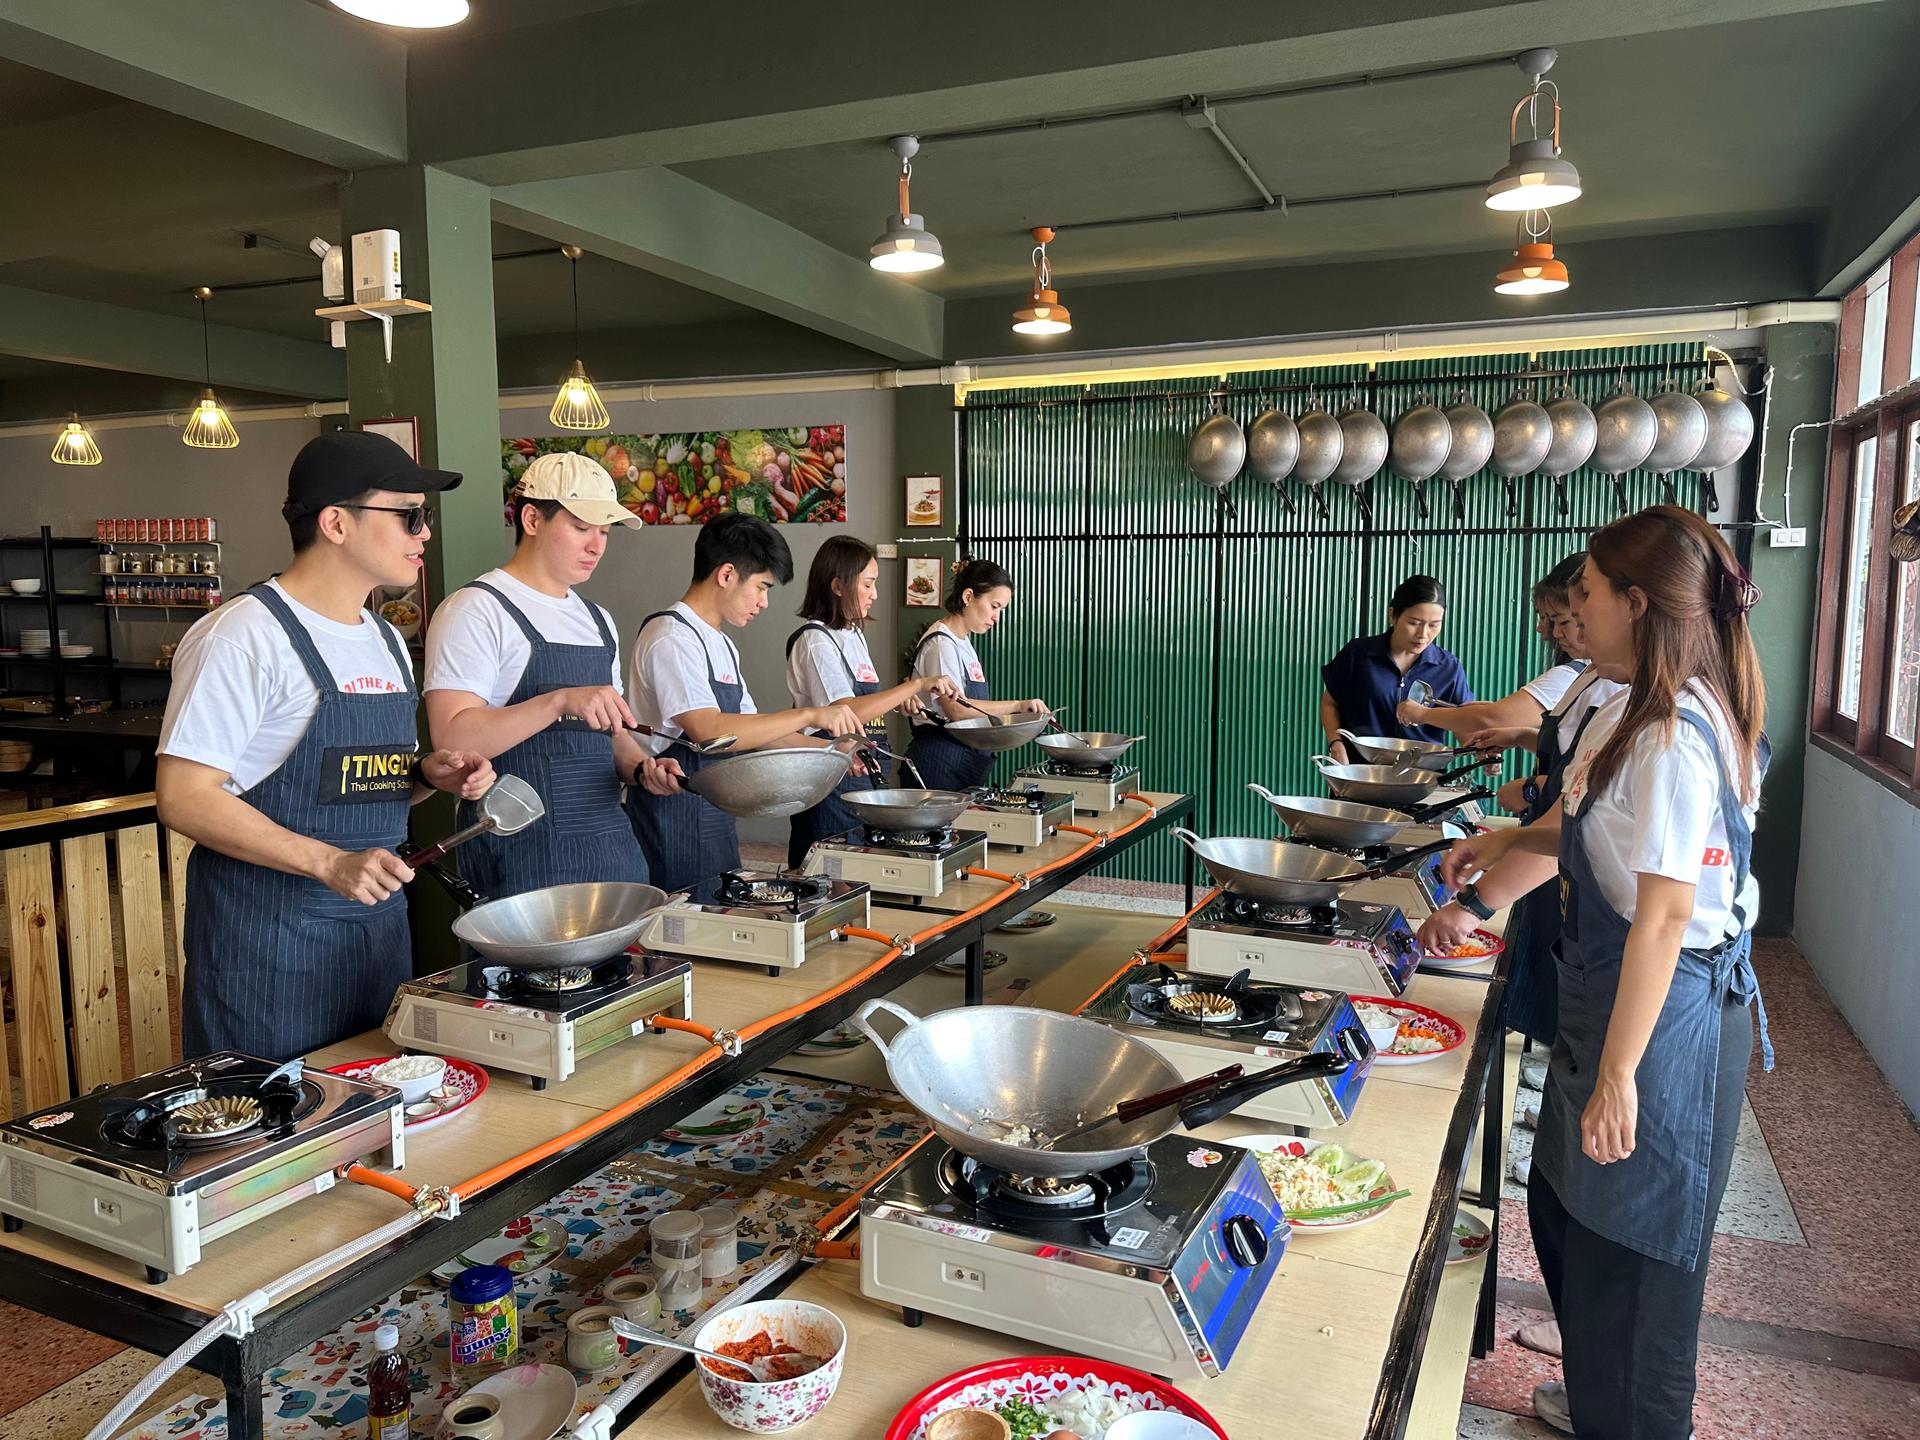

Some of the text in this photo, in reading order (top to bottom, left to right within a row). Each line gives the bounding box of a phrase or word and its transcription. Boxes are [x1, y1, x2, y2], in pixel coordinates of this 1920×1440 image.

[357, 677, 382, 689] THE
[350, 781, 368, 792] Thai
[369, 780, 396, 791] Cooking
